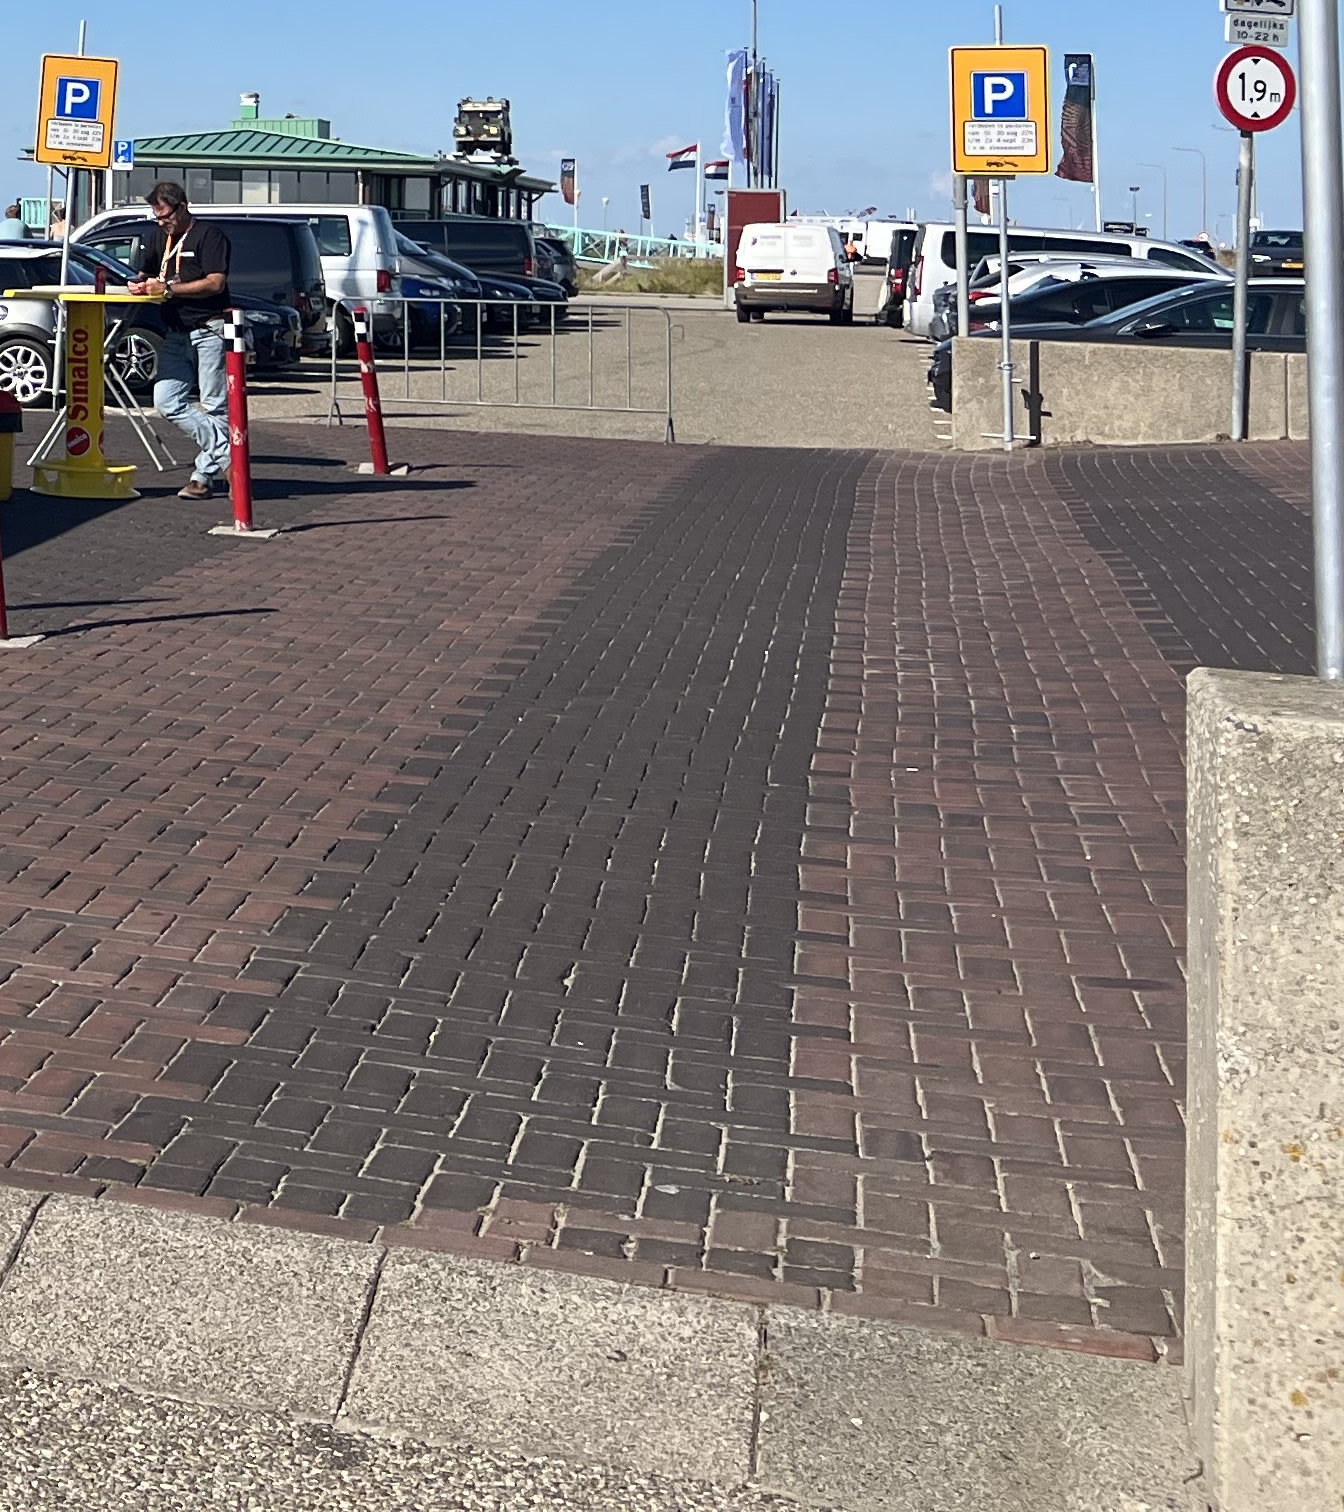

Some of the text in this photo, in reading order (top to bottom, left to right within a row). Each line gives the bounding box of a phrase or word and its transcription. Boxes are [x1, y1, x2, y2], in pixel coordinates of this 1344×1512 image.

[1233, 18, 1285, 31] dagelijks
[1272, 32, 1280, 42] h
[64, 82, 90, 115] P
[983, 76, 1015, 114] P
[1238, 72, 1281, 104] 1,9 m
[67, 328, 89, 422] Sinalco
